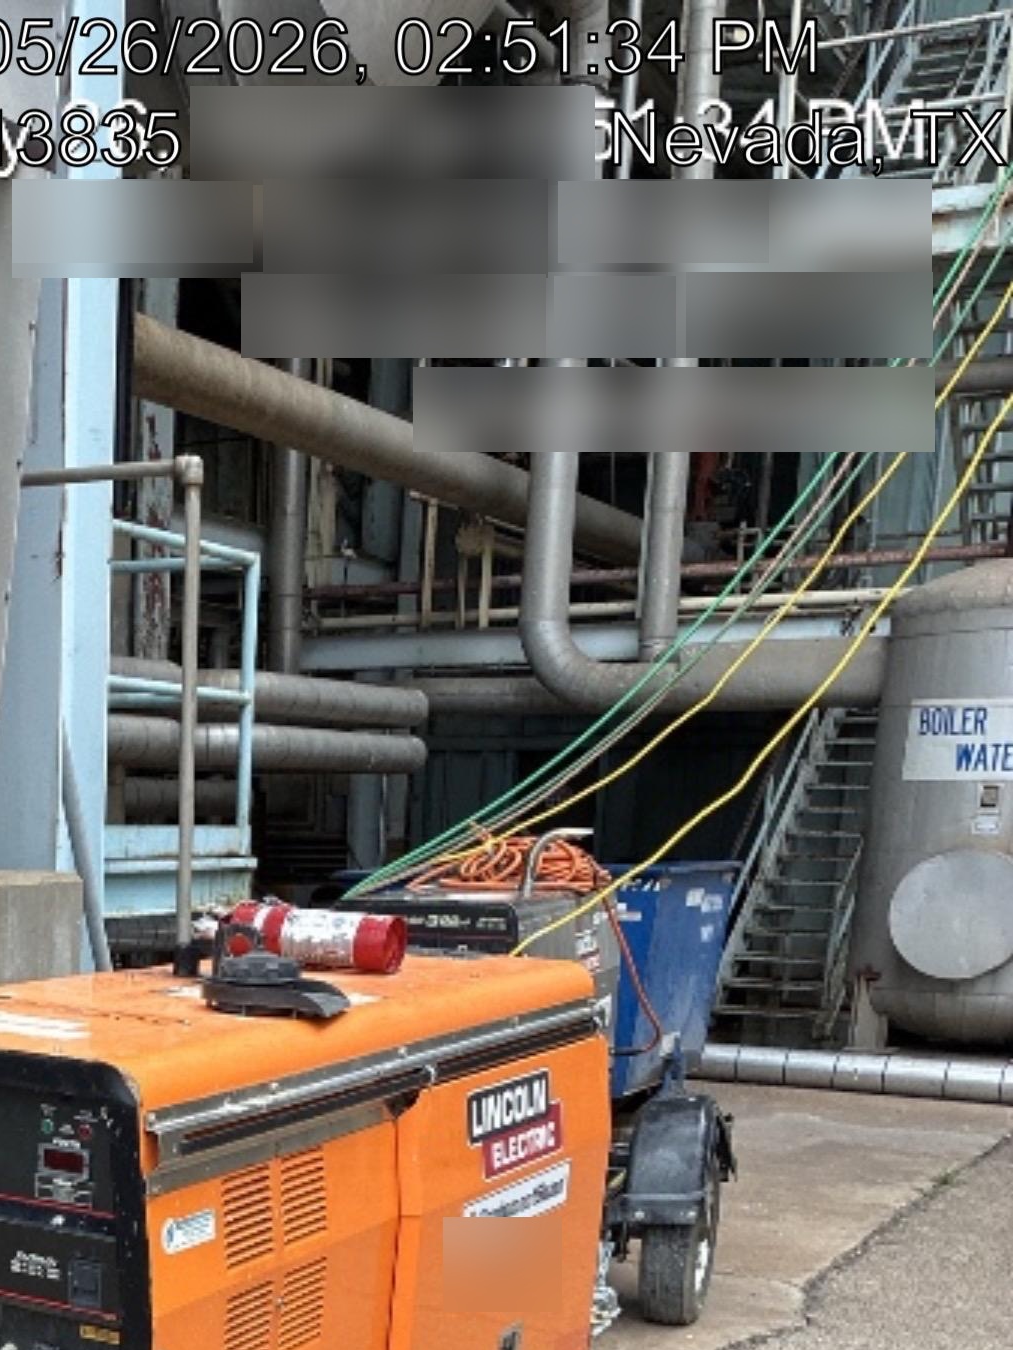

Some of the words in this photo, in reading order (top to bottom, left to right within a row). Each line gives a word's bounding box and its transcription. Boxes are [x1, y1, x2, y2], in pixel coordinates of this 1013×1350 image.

[919, 706, 987, 736] BOILER
[471, 1078, 547, 1138] LINCOLN
[491, 1121, 556, 1170] ELECTRIC
